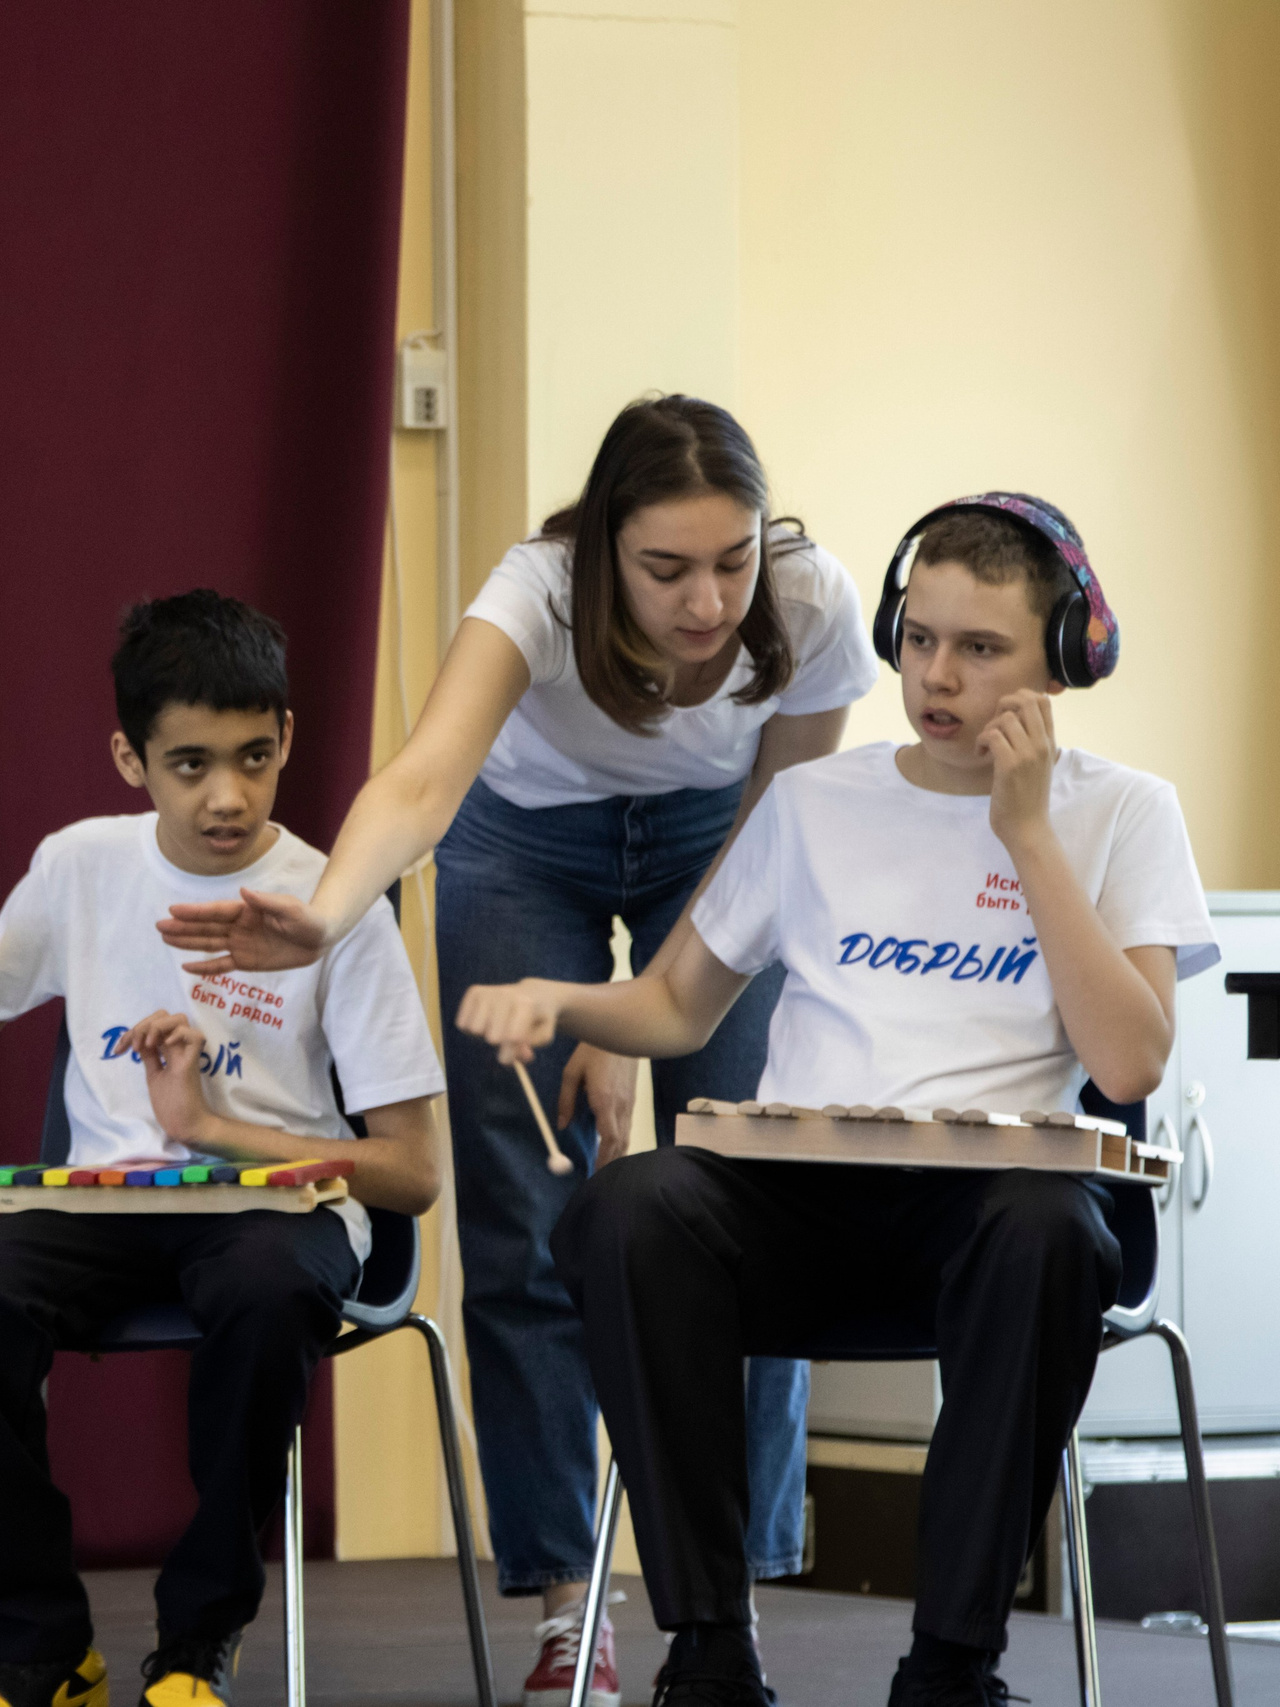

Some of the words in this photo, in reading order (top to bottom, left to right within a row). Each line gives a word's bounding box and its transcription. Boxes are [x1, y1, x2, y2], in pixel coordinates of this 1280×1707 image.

[976, 891, 1021, 911] быть
[986, 872, 1024, 896] Иск
[836, 933, 1039, 984] ДОБРЫЙ
[191, 985, 226, 1009] быть
[230, 1002, 284, 1030] рядом
